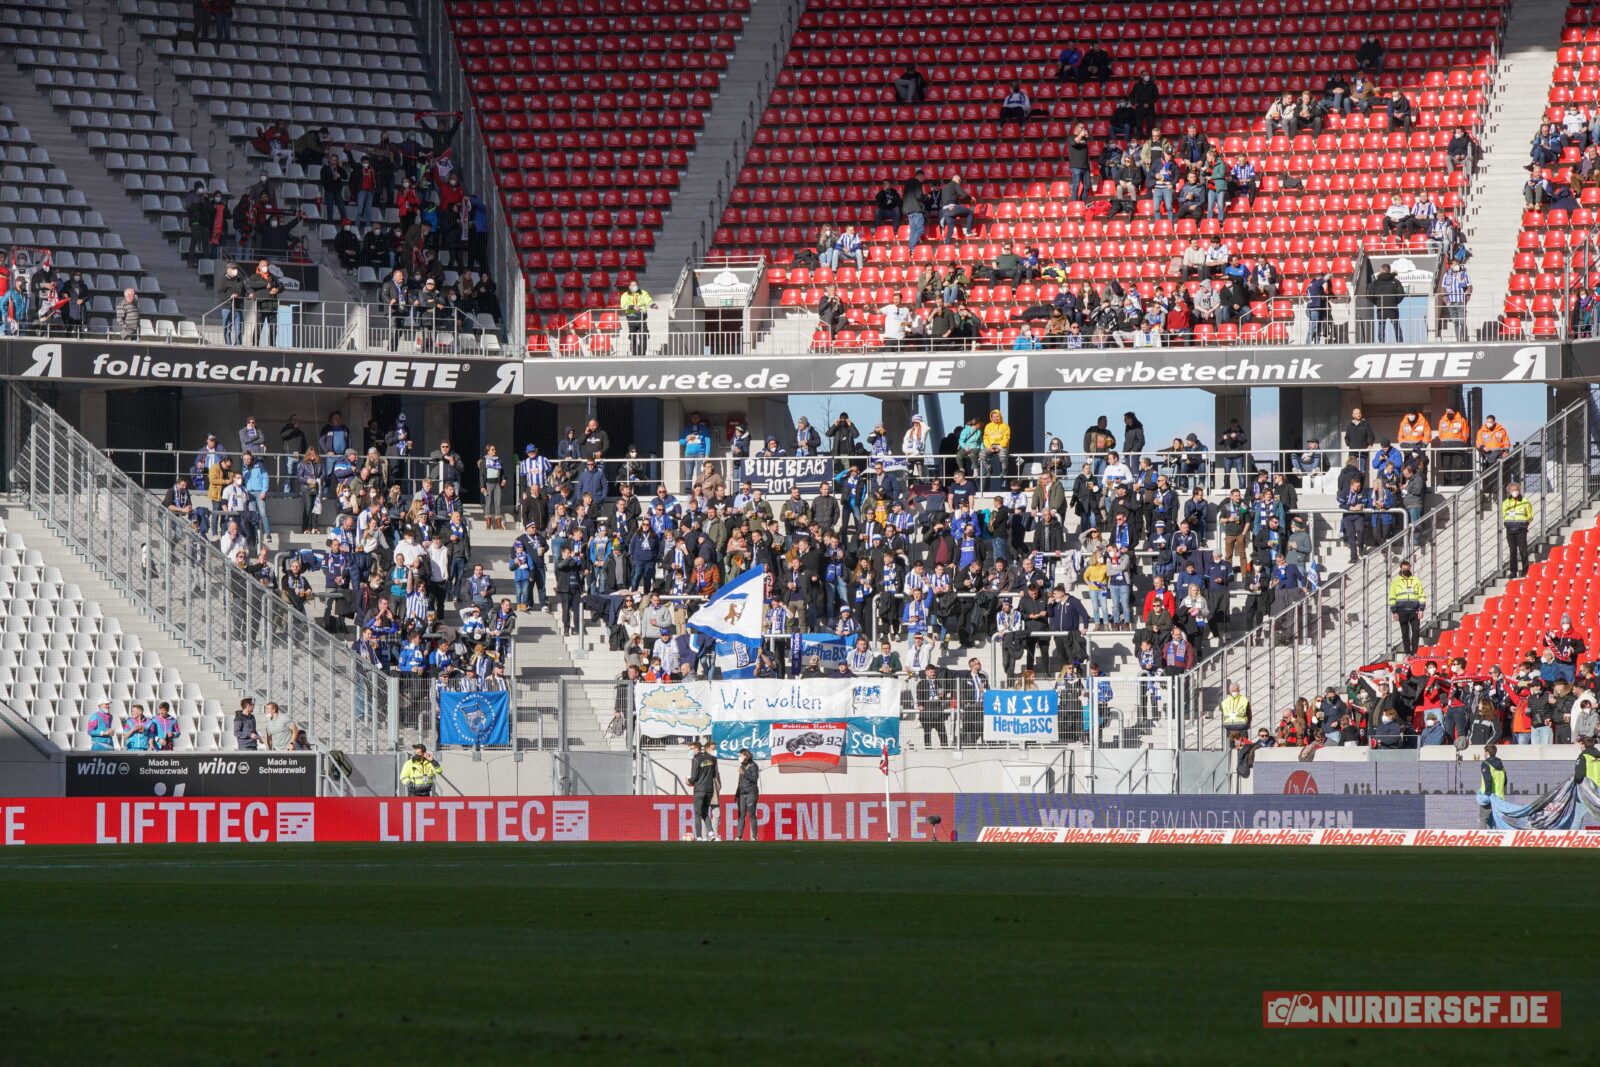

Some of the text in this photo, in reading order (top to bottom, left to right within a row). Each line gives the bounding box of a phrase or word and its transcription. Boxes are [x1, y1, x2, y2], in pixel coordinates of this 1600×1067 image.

[93, 354, 324, 384] folientechnik
[1055, 358, 1324, 383] werbetechnik
[555, 368, 790, 391] www.rete.de
[744, 459, 827, 478] BLUE BEARS
[765, 477, 795, 494] 2017
[720, 686, 822, 710] Wir wollen
[720, 728, 764, 751] euch
[77, 758, 116, 775] wiha
[139, 767, 189, 775] Schwarzwald
[148, 759, 180, 767] Made im
[198, 758, 237, 774] wiha
[259, 766, 306, 774] Schwarzwald
[267, 758, 298, 767] Made im
[96, 802, 269, 844] LIFTTEC
[379, 801, 545, 841] LIFTTEC
[653, 801, 926, 841] TRPPENLIFTE
[1038, 805, 1354, 829] WIR ÜBERWINDEN GRENZEN
[981, 828, 1058, 843] WeberHaus
[1063, 829, 1141, 843] WeberHaus
[1147, 829, 1226, 844] WeberHaus
[1231, 829, 1314, 844] WeberHaus
[1319, 829, 1406, 845] WeberHaus
[1413, 830, 1504, 847] WeberHaus
